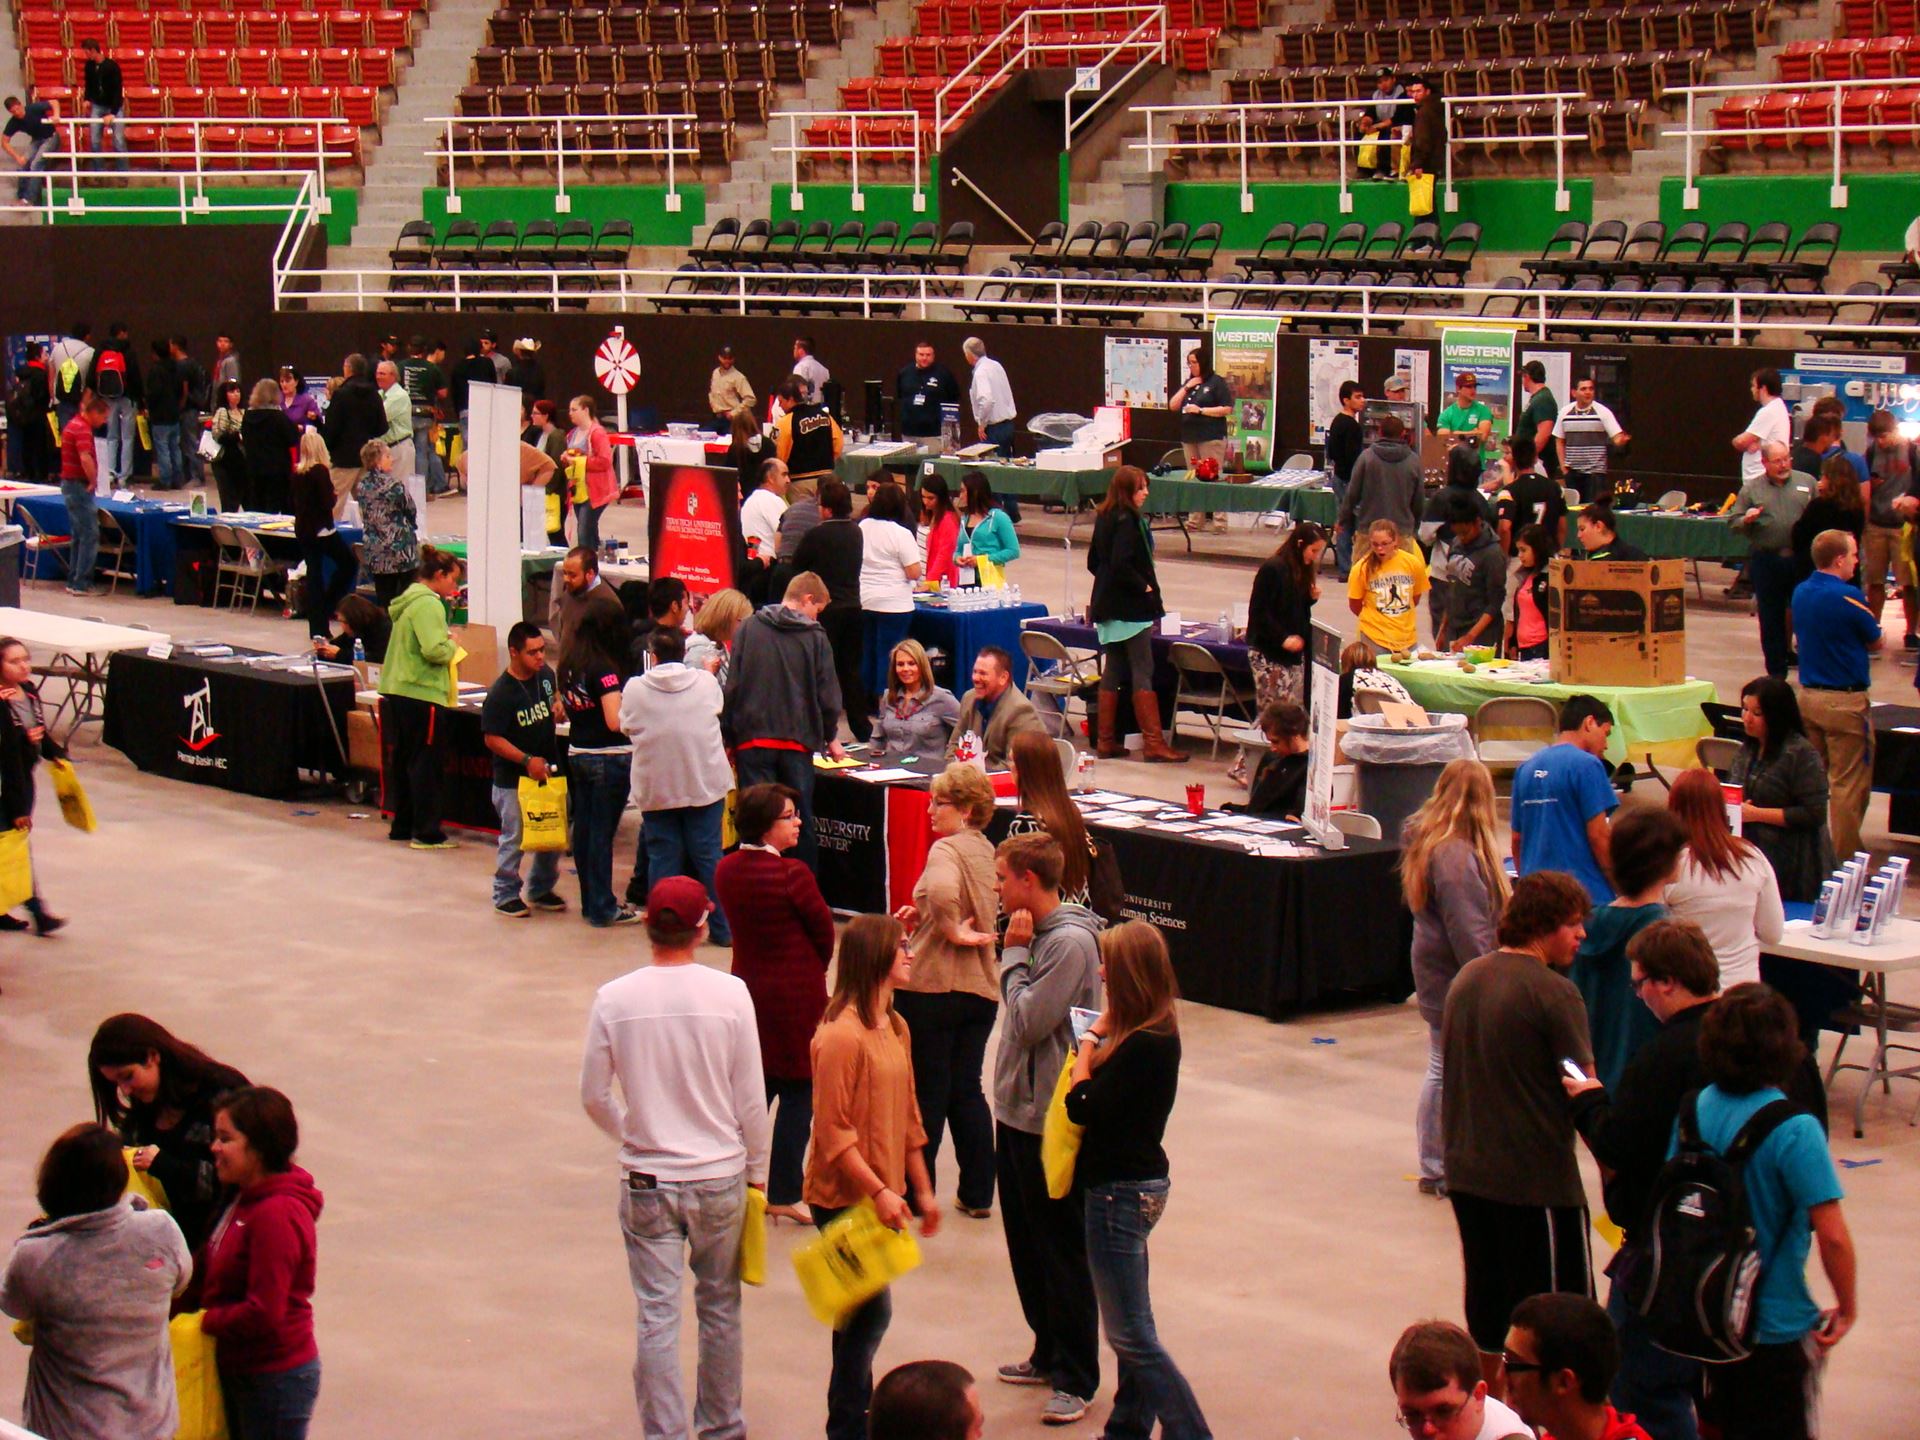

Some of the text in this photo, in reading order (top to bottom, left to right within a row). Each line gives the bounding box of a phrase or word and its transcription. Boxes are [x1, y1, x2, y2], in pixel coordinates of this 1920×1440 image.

[1216, 331, 1274, 343] WESTERN
[1445, 345, 1510, 358] WESTERN
[1532, 501, 1546, 525] 7
[1369, 575, 1415, 590] CHAMPIONS
[517, 700, 550, 727] CLASS
[1149, 911, 1187, 930] Sciences
